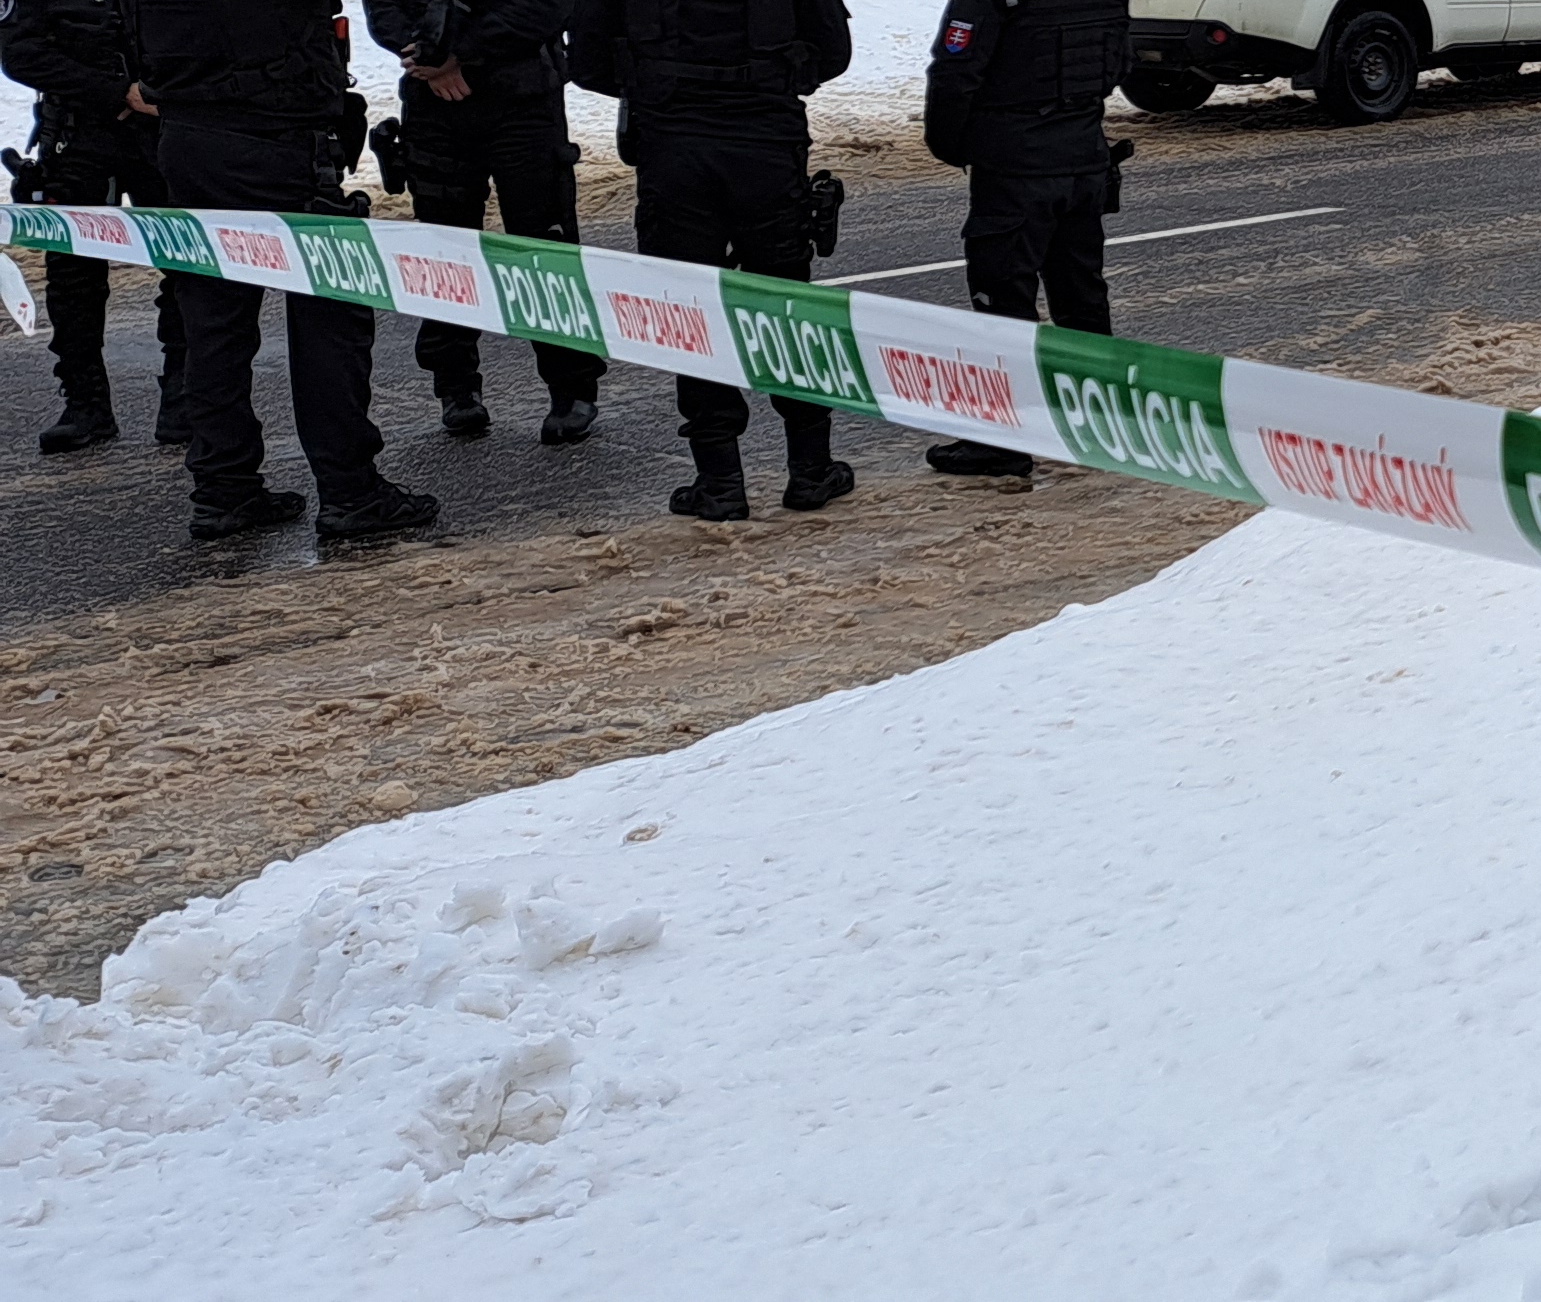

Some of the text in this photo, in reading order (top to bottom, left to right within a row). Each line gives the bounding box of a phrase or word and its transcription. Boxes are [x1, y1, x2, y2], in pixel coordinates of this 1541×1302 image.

[300, 225, 387, 298] POLÍCIA
[495, 254, 599, 342] POLÍCIA
[734, 299, 867, 402] POLÍCIA
[879, 345, 1022, 429] VSTUP ZAKÁZANÝ
[1053, 364, 1247, 489] POLÍCIA
[1257, 426, 1473, 533] VSTUP ZAKÁZANÝ
